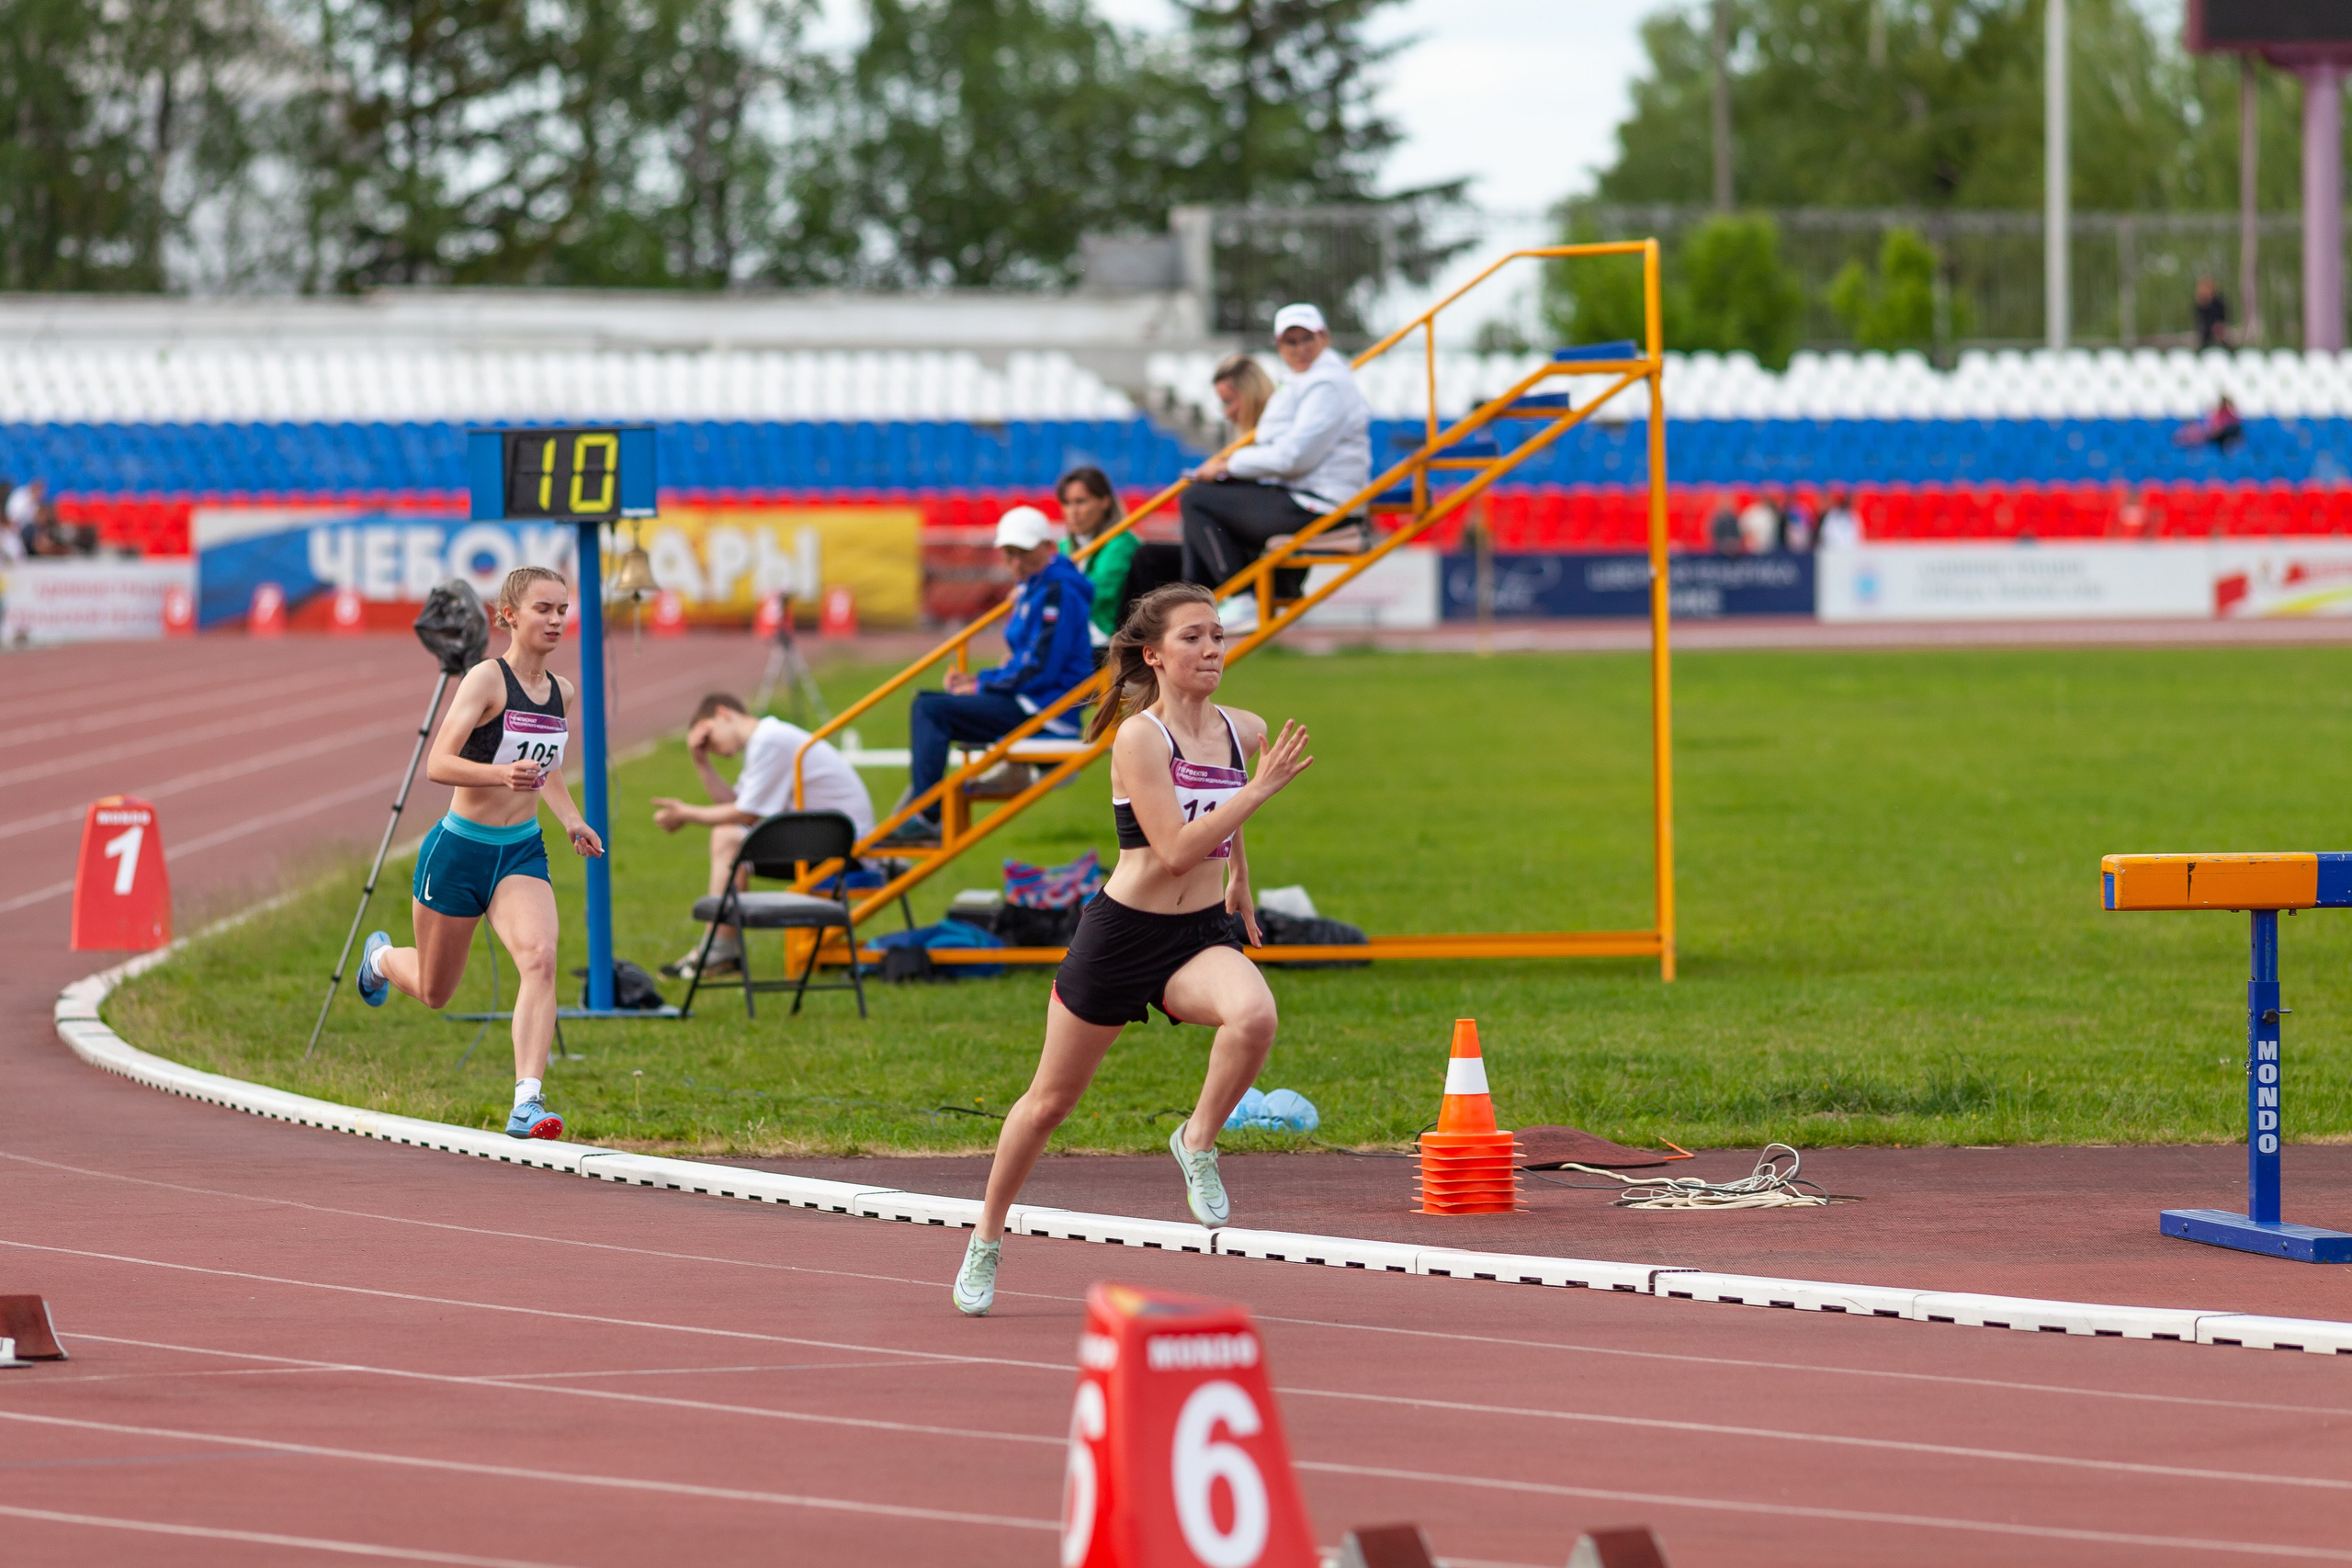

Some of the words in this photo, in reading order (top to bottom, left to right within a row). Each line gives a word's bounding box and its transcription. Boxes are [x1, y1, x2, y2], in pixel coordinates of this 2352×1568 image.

[538, 433, 619, 514] 10
[513, 741, 559, 768] 105
[105, 826, 143, 896] 1
[2257, 1040, 2278, 1154] MONDO
[1170, 1378, 1270, 1568] 6
